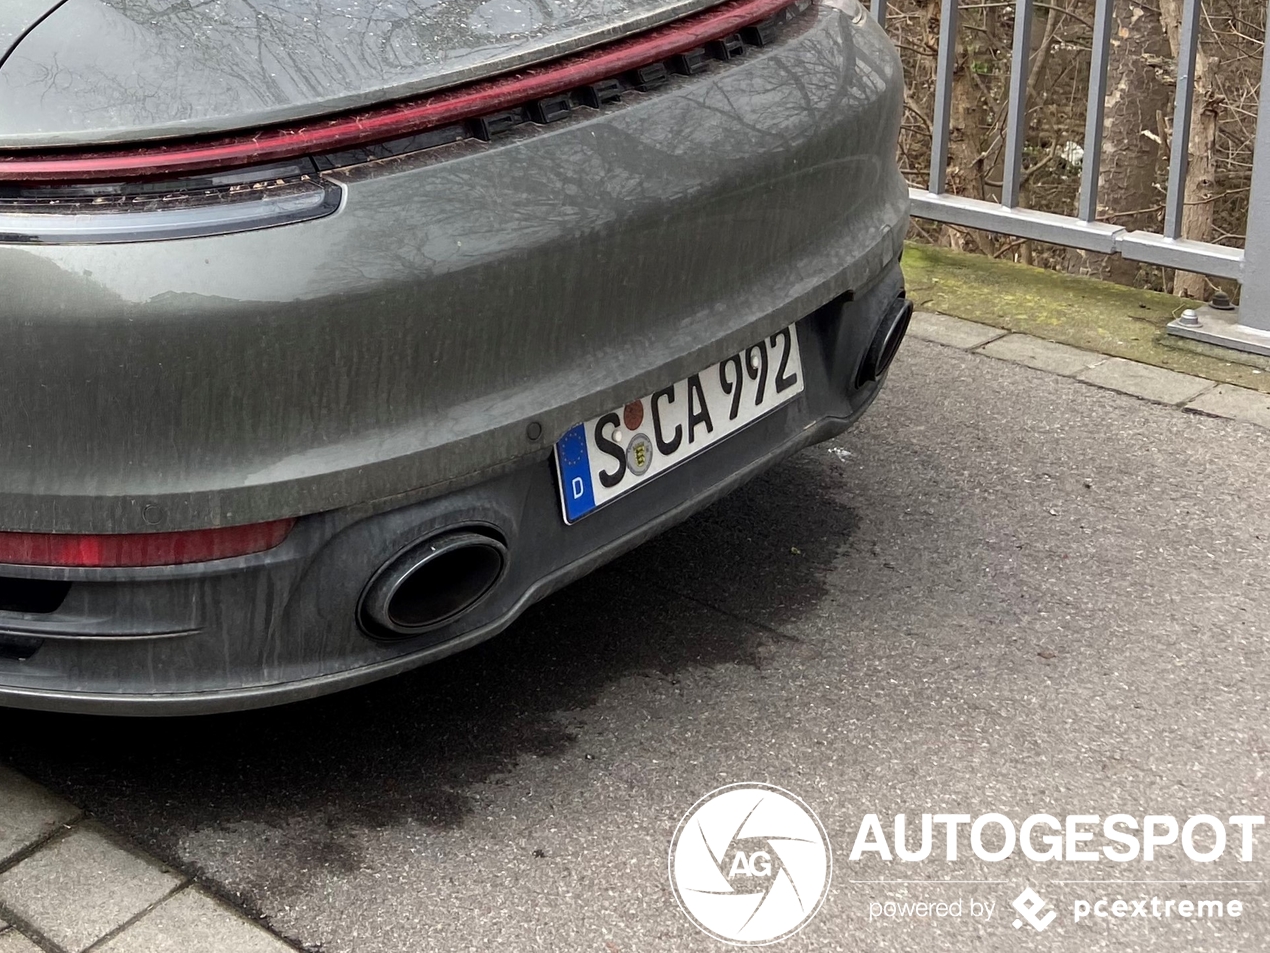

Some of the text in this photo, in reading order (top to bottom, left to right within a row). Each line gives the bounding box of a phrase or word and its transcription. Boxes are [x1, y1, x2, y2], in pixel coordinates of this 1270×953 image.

[594, 327, 798, 489] S CA 992
[571, 476, 585, 500] D
